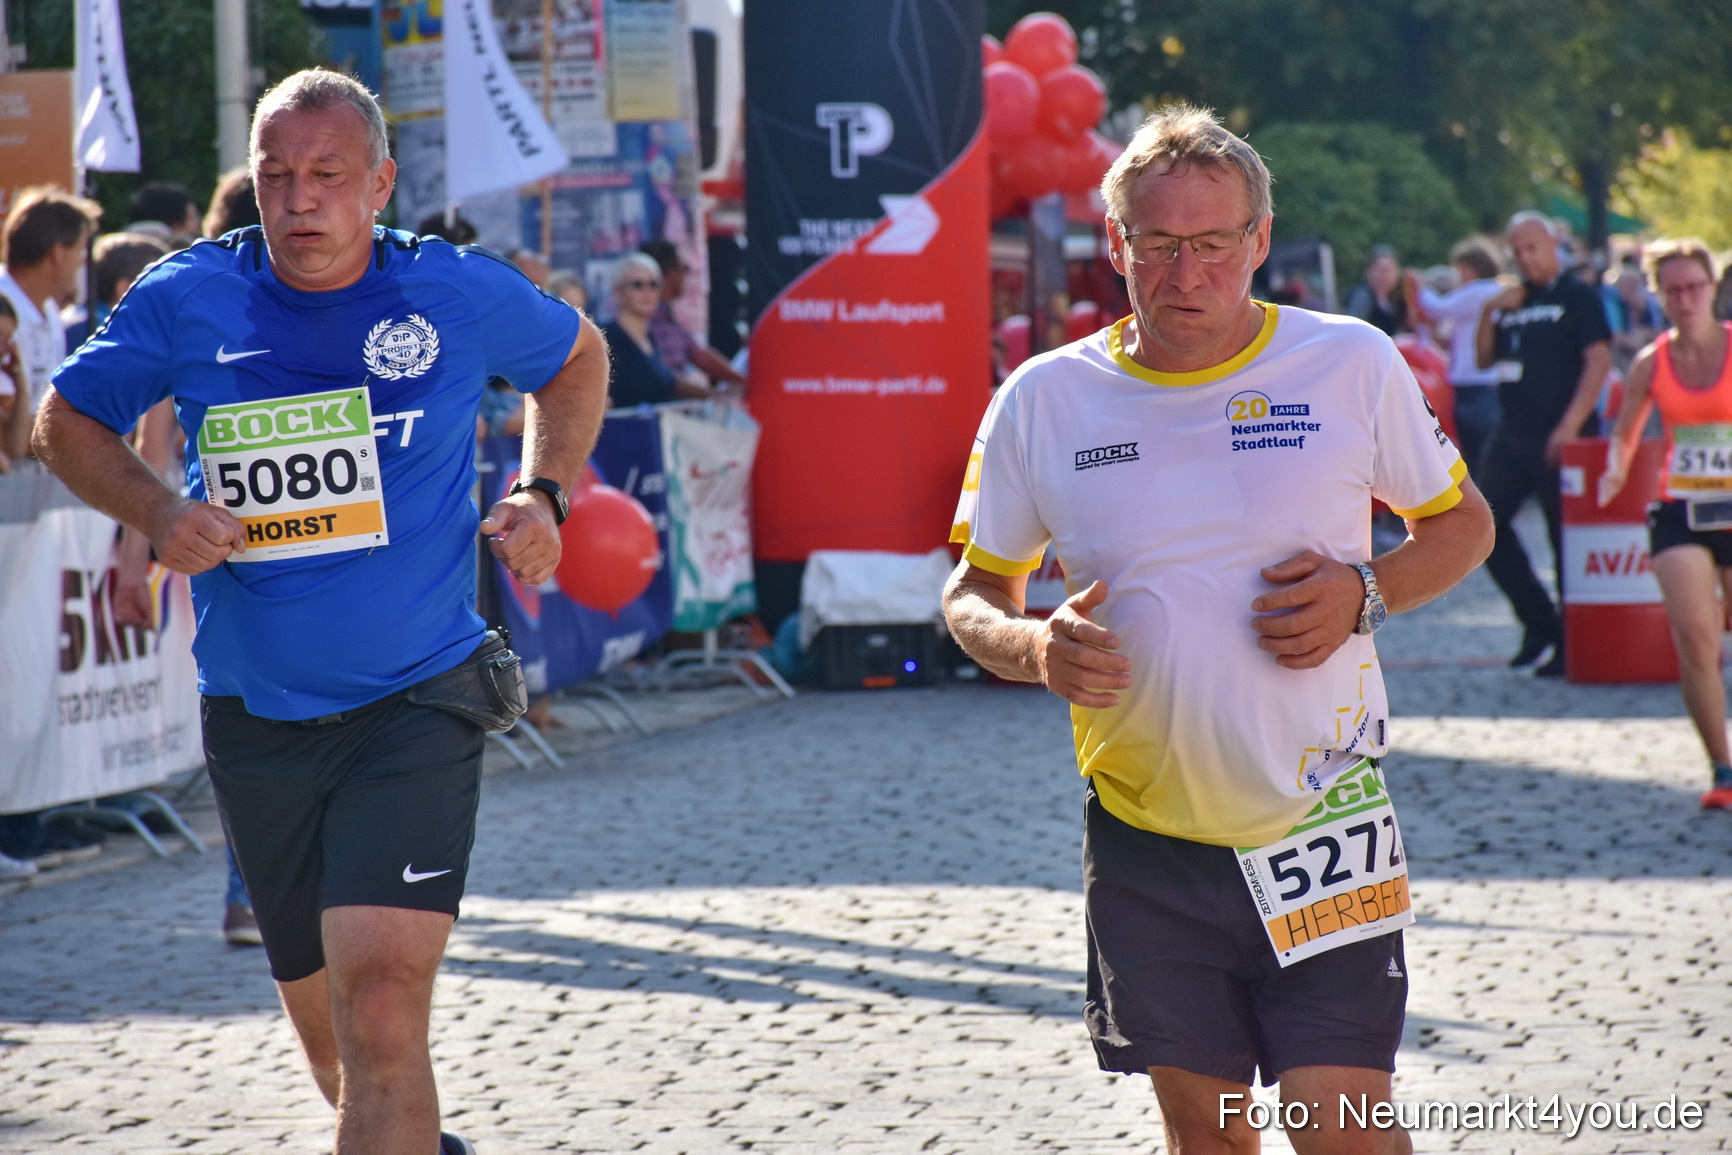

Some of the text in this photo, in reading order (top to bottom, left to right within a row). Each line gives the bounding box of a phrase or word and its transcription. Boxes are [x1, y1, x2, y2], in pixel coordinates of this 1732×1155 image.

[837, 298, 945, 326] Laufsport
[204, 397, 358, 448] BOCK
[1231, 398, 1307, 421] 20 JAHRE
[1231, 420, 1322, 435] Neumarkter
[1075, 442, 1139, 467] BOCK
[1231, 436, 1306, 451] Stadtlauf
[1116, 456, 1140, 464] concepts
[218, 448, 358, 508] 5080
[360, 448, 368, 458] S
[246, 513, 337, 543] HORST
[1267, 815, 1401, 901] 5272
